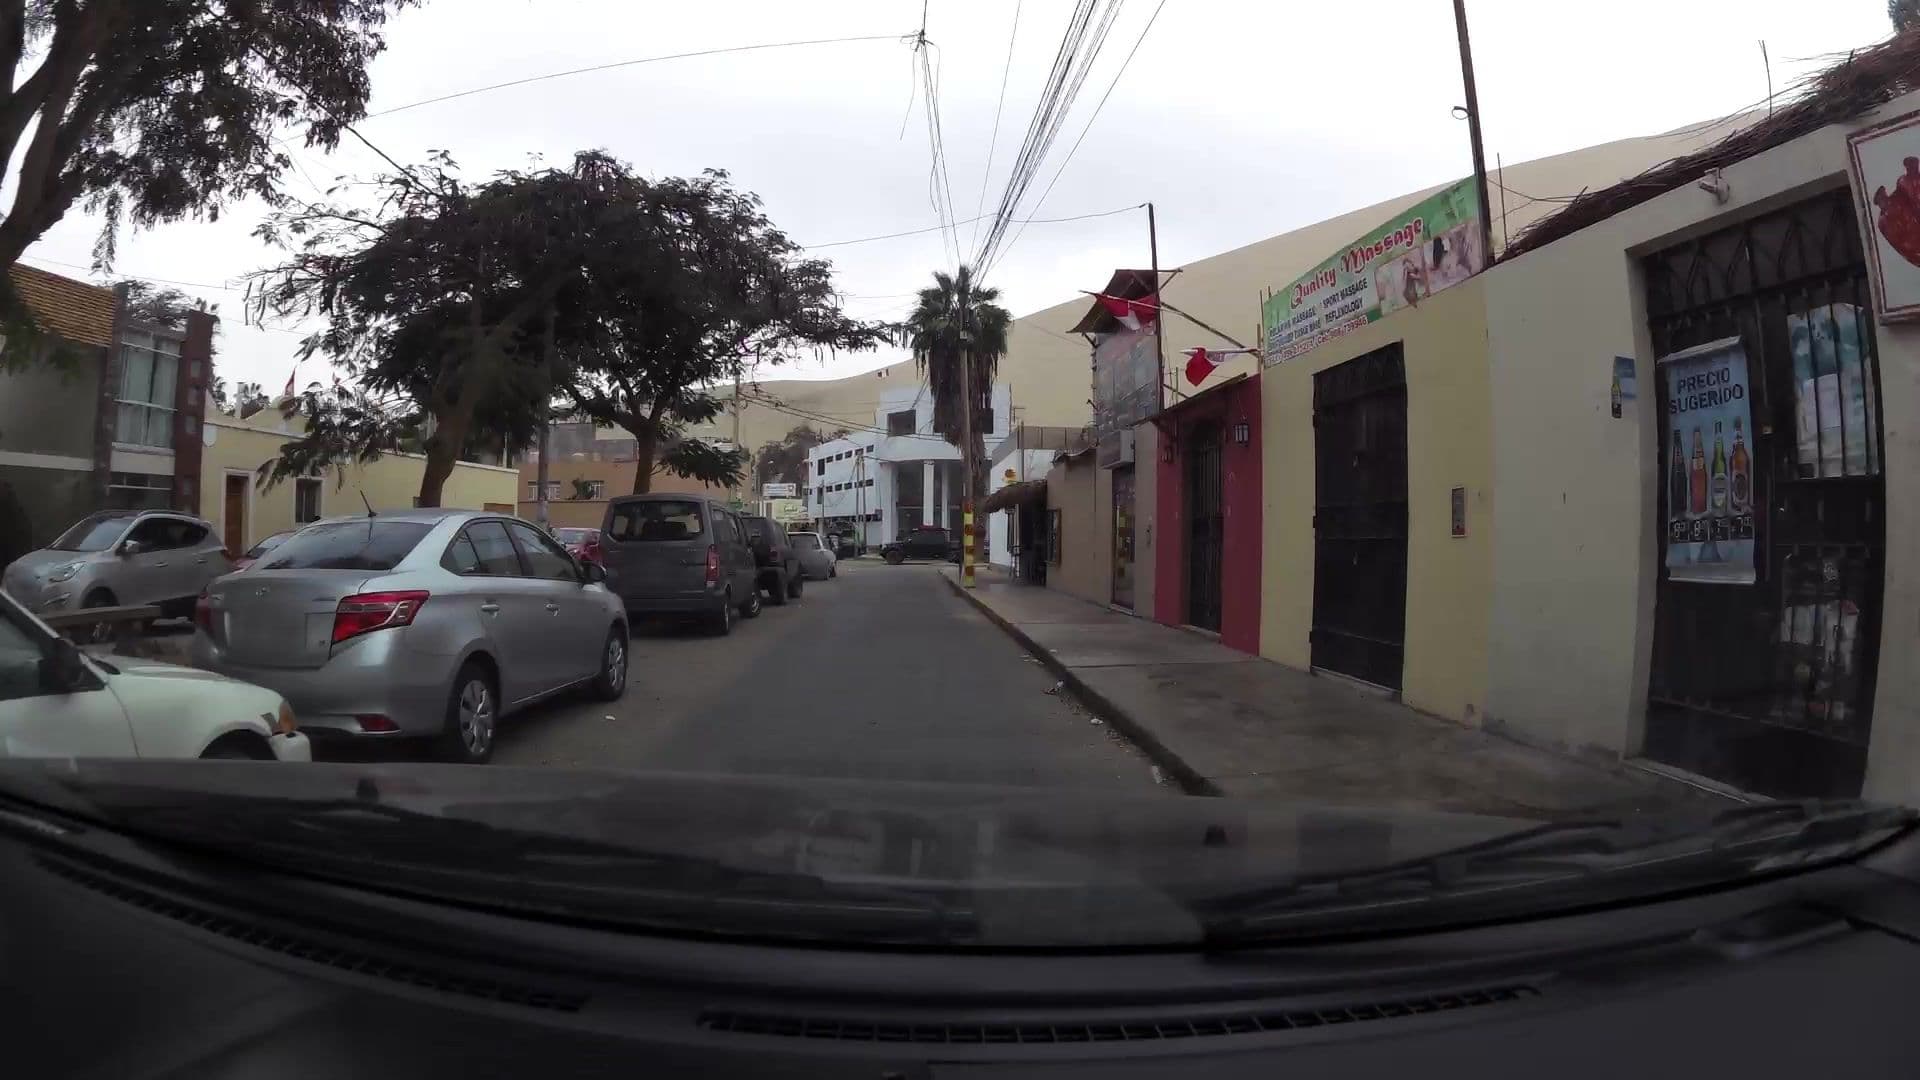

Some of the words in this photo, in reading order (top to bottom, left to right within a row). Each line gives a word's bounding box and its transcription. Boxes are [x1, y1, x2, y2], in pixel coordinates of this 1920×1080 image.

[1291, 267, 1337, 309] Quality
[1341, 217, 1423, 274] Massage
[1322, 292, 1340, 309] SPORT
[1340, 278, 1368, 300] MASSAGE
[1677, 367, 1730, 394] PRECIO
[1670, 383, 1744, 415] SUGERIDO
